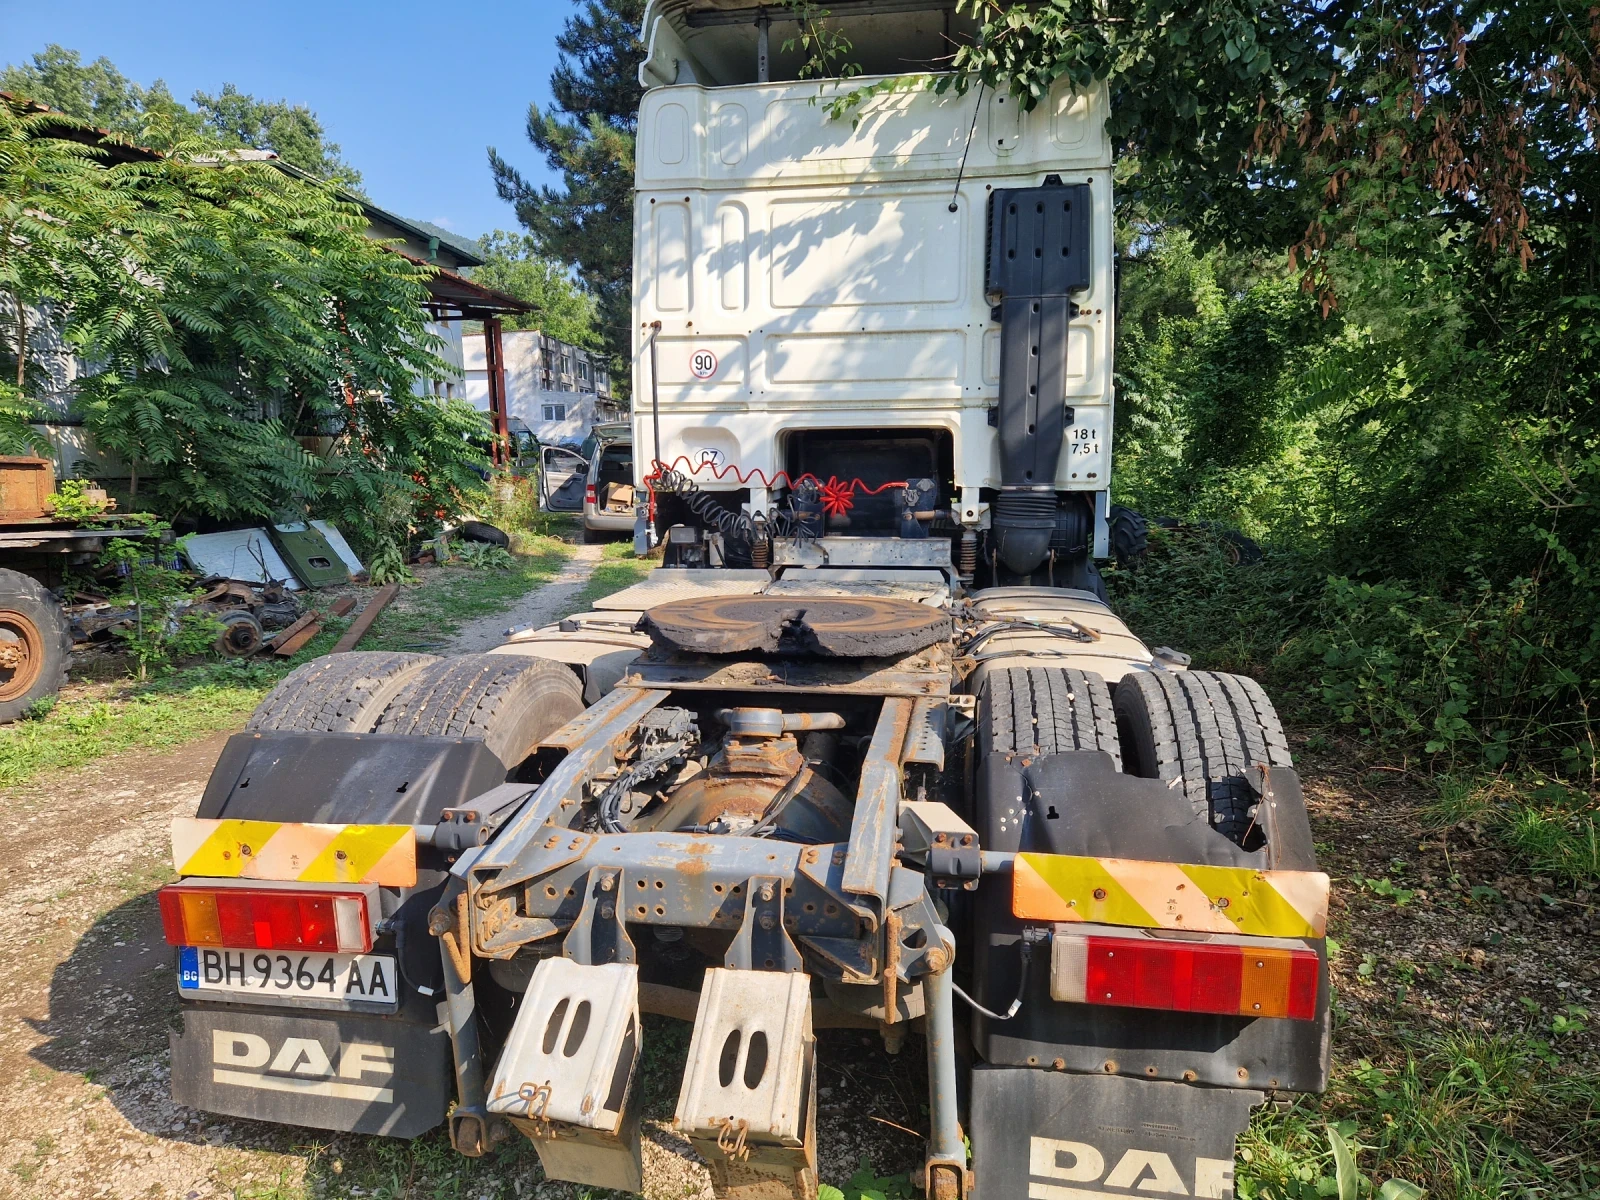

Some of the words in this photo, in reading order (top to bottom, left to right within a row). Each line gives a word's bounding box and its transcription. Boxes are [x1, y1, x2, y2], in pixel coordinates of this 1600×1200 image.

[695, 355, 712, 370] 90
[1073, 429, 1088, 439] 18
[1091, 429, 1096, 439] t
[1071, 443, 1090, 456] 7,5
[1094, 443, 1099, 453] t
[183, 970, 198, 981] BG
[203, 949, 246, 987] BH
[253, 954, 336, 993] 9364
[346, 960, 389, 997] AA
[213, 1029, 395, 1079] DAF
[1029, 1136, 1235, 1200] DAF
